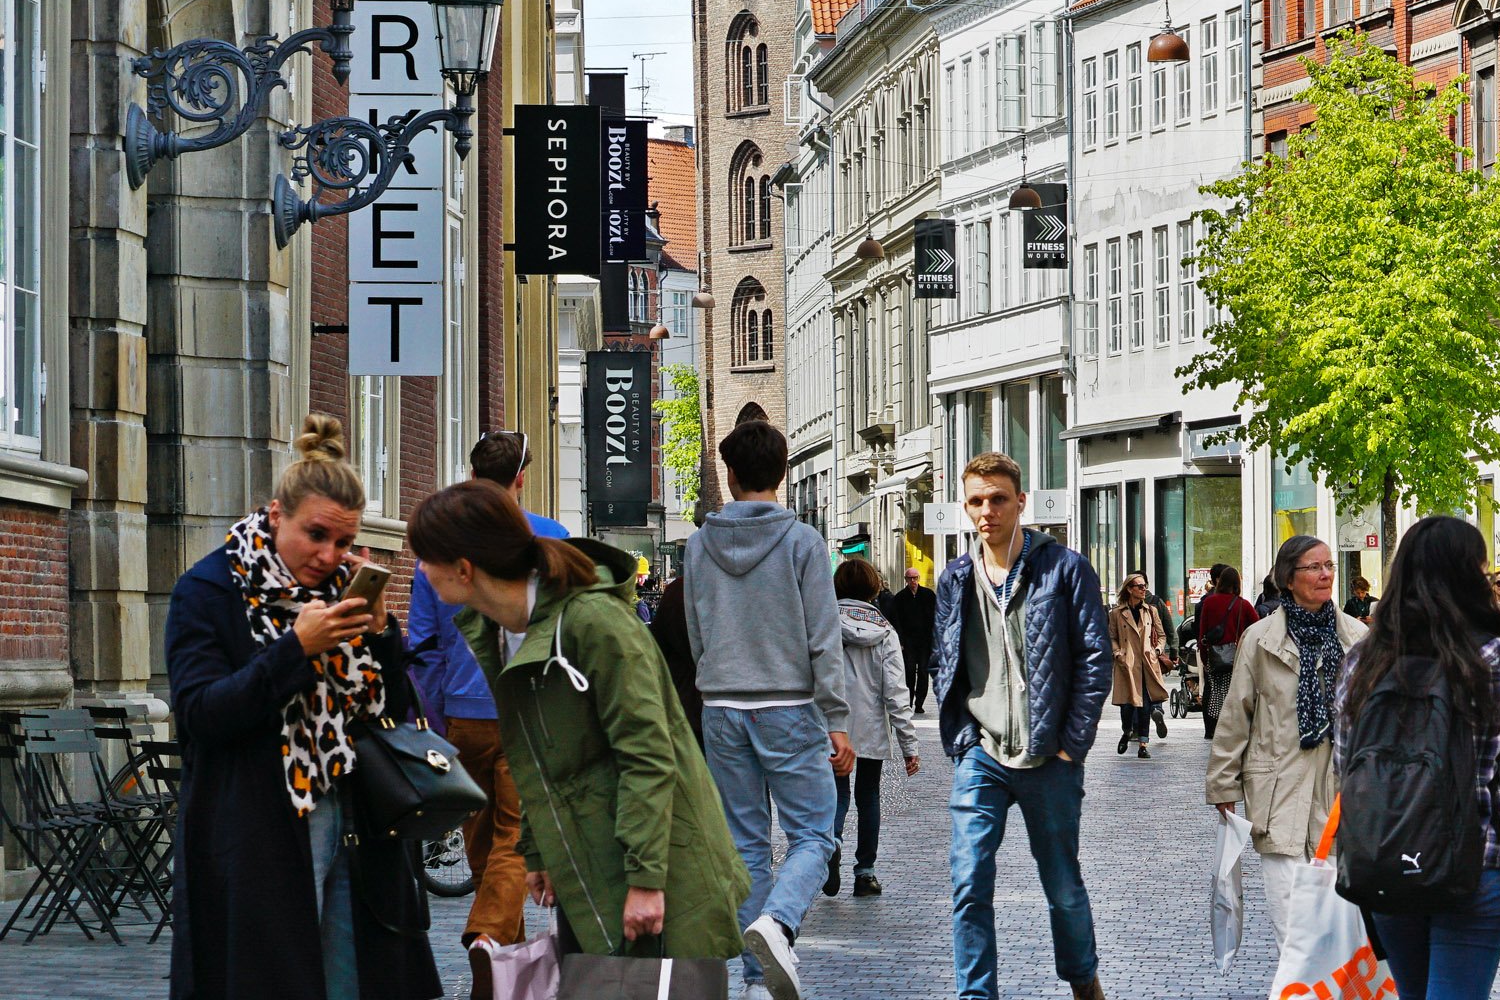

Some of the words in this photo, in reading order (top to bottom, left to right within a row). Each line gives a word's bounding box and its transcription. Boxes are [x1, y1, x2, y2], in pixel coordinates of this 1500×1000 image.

[624, 172, 631, 182] BY
[547, 119, 568, 261] SEPHORA
[1027, 242, 1065, 251] FITNESS
[918, 274, 953, 282] FITNESS
[631, 392, 640, 437] BEAUTY
[631, 442, 640, 453] BY
